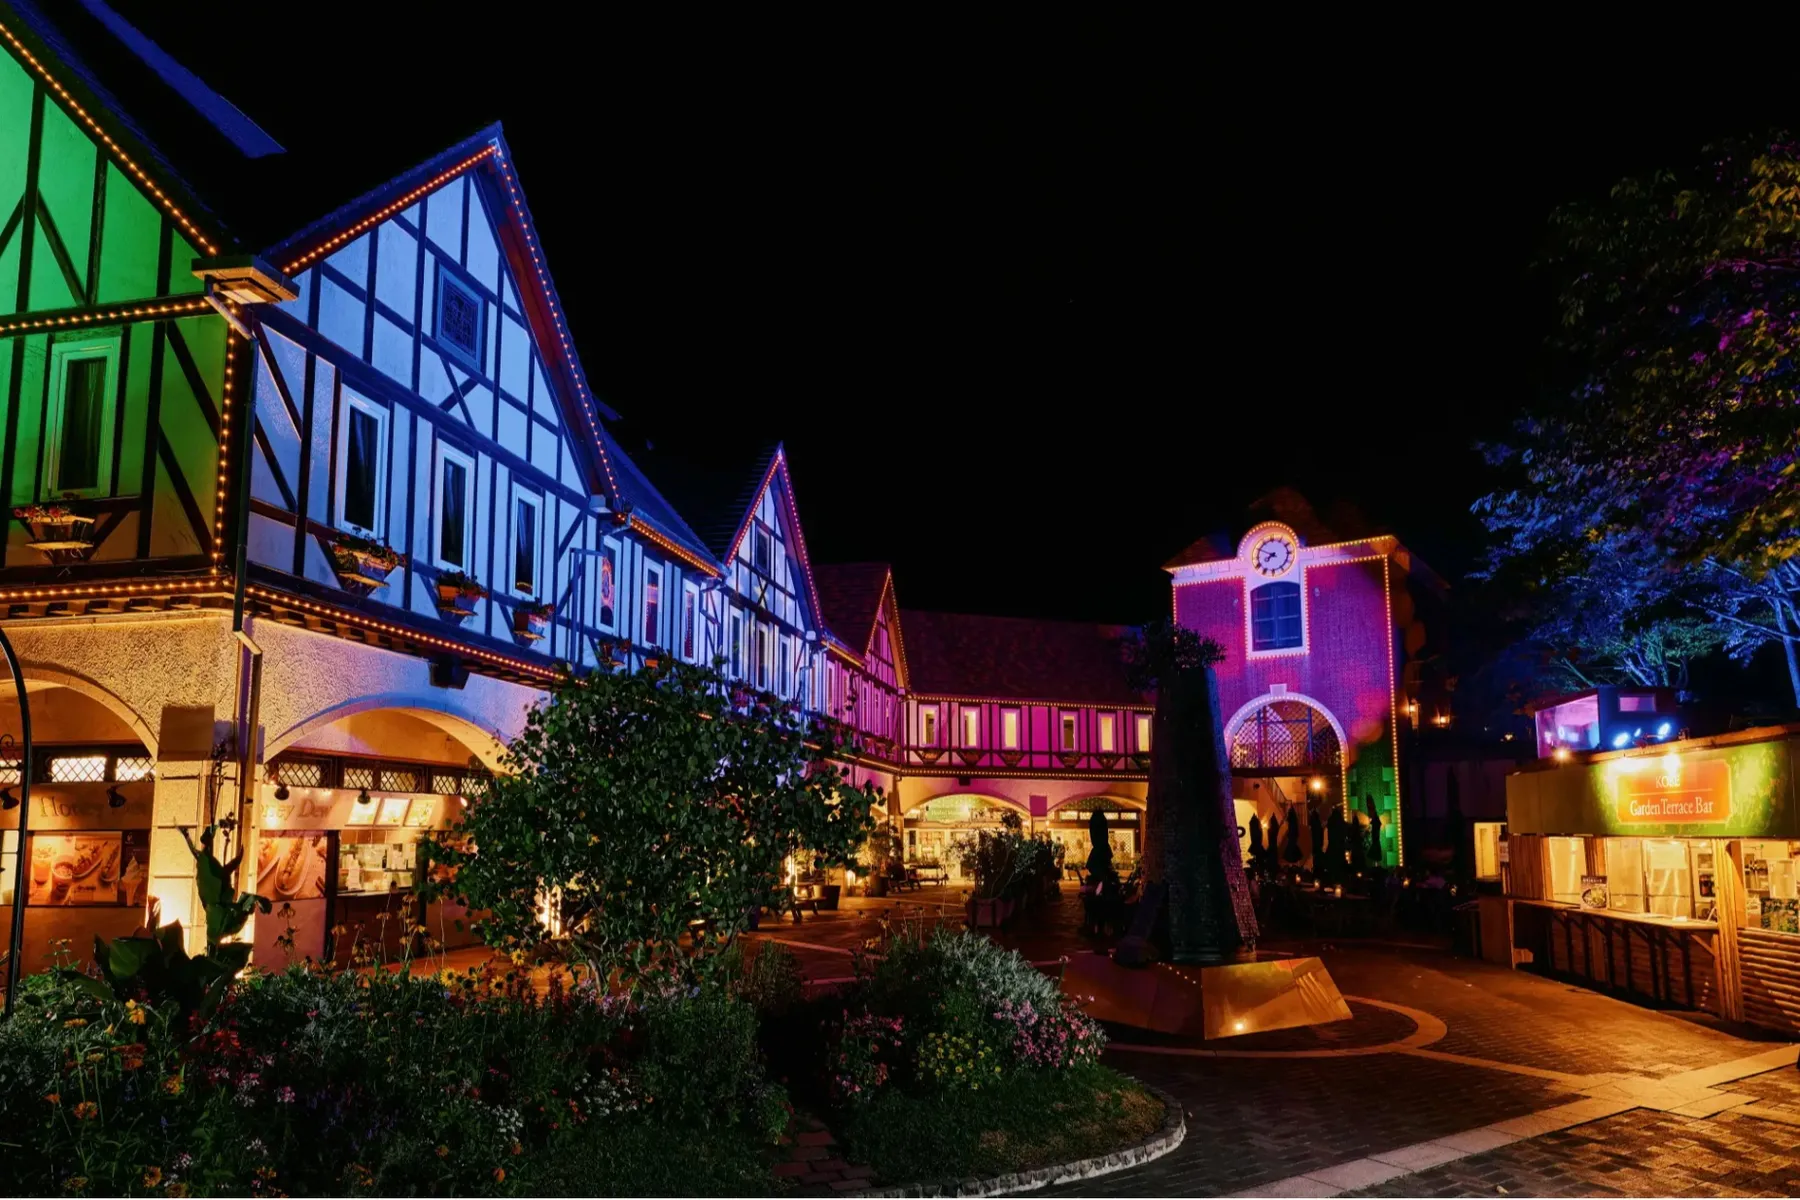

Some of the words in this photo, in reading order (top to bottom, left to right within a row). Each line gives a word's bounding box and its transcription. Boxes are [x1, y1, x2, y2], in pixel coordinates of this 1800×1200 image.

[1630, 799, 1660, 816] Garden
[1661, 798, 1693, 815] Terrace
[1695, 796, 1713, 814] Bar
